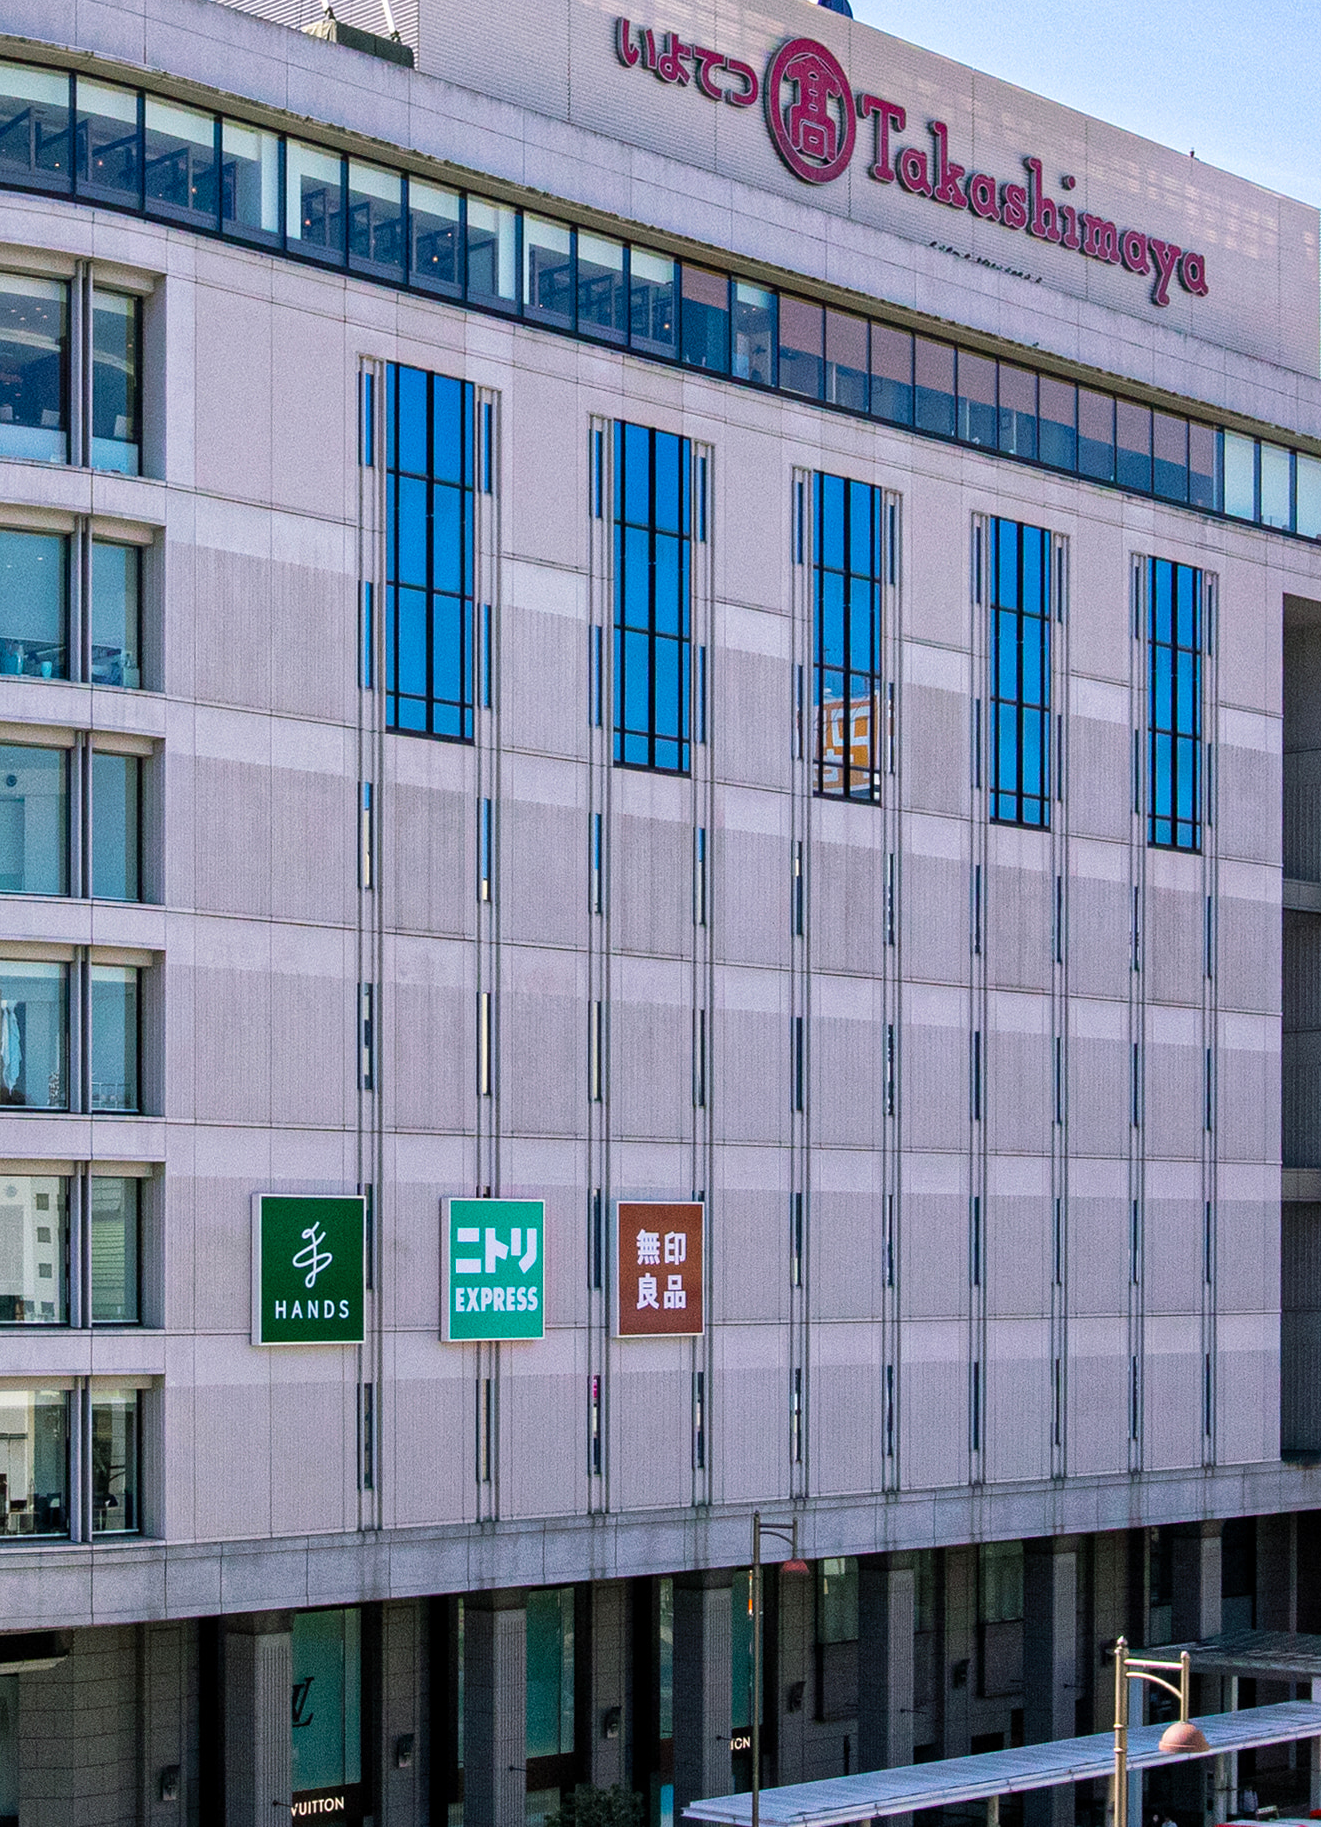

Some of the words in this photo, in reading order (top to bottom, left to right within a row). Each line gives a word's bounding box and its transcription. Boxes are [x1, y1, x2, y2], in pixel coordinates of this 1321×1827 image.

[620, 19, 759, 107] いよてつ
[860, 93, 1209, 306] Takashimaya
[455, 1227, 537, 1273] ニトリ
[636, 1229, 686, 1266] 無印
[275, 1300, 349, 1319] HANDS
[455, 1286, 538, 1313] EXPRESS
[636, 1272, 687, 1310] 良品
[290, 1796, 345, 1817] VUITTON
